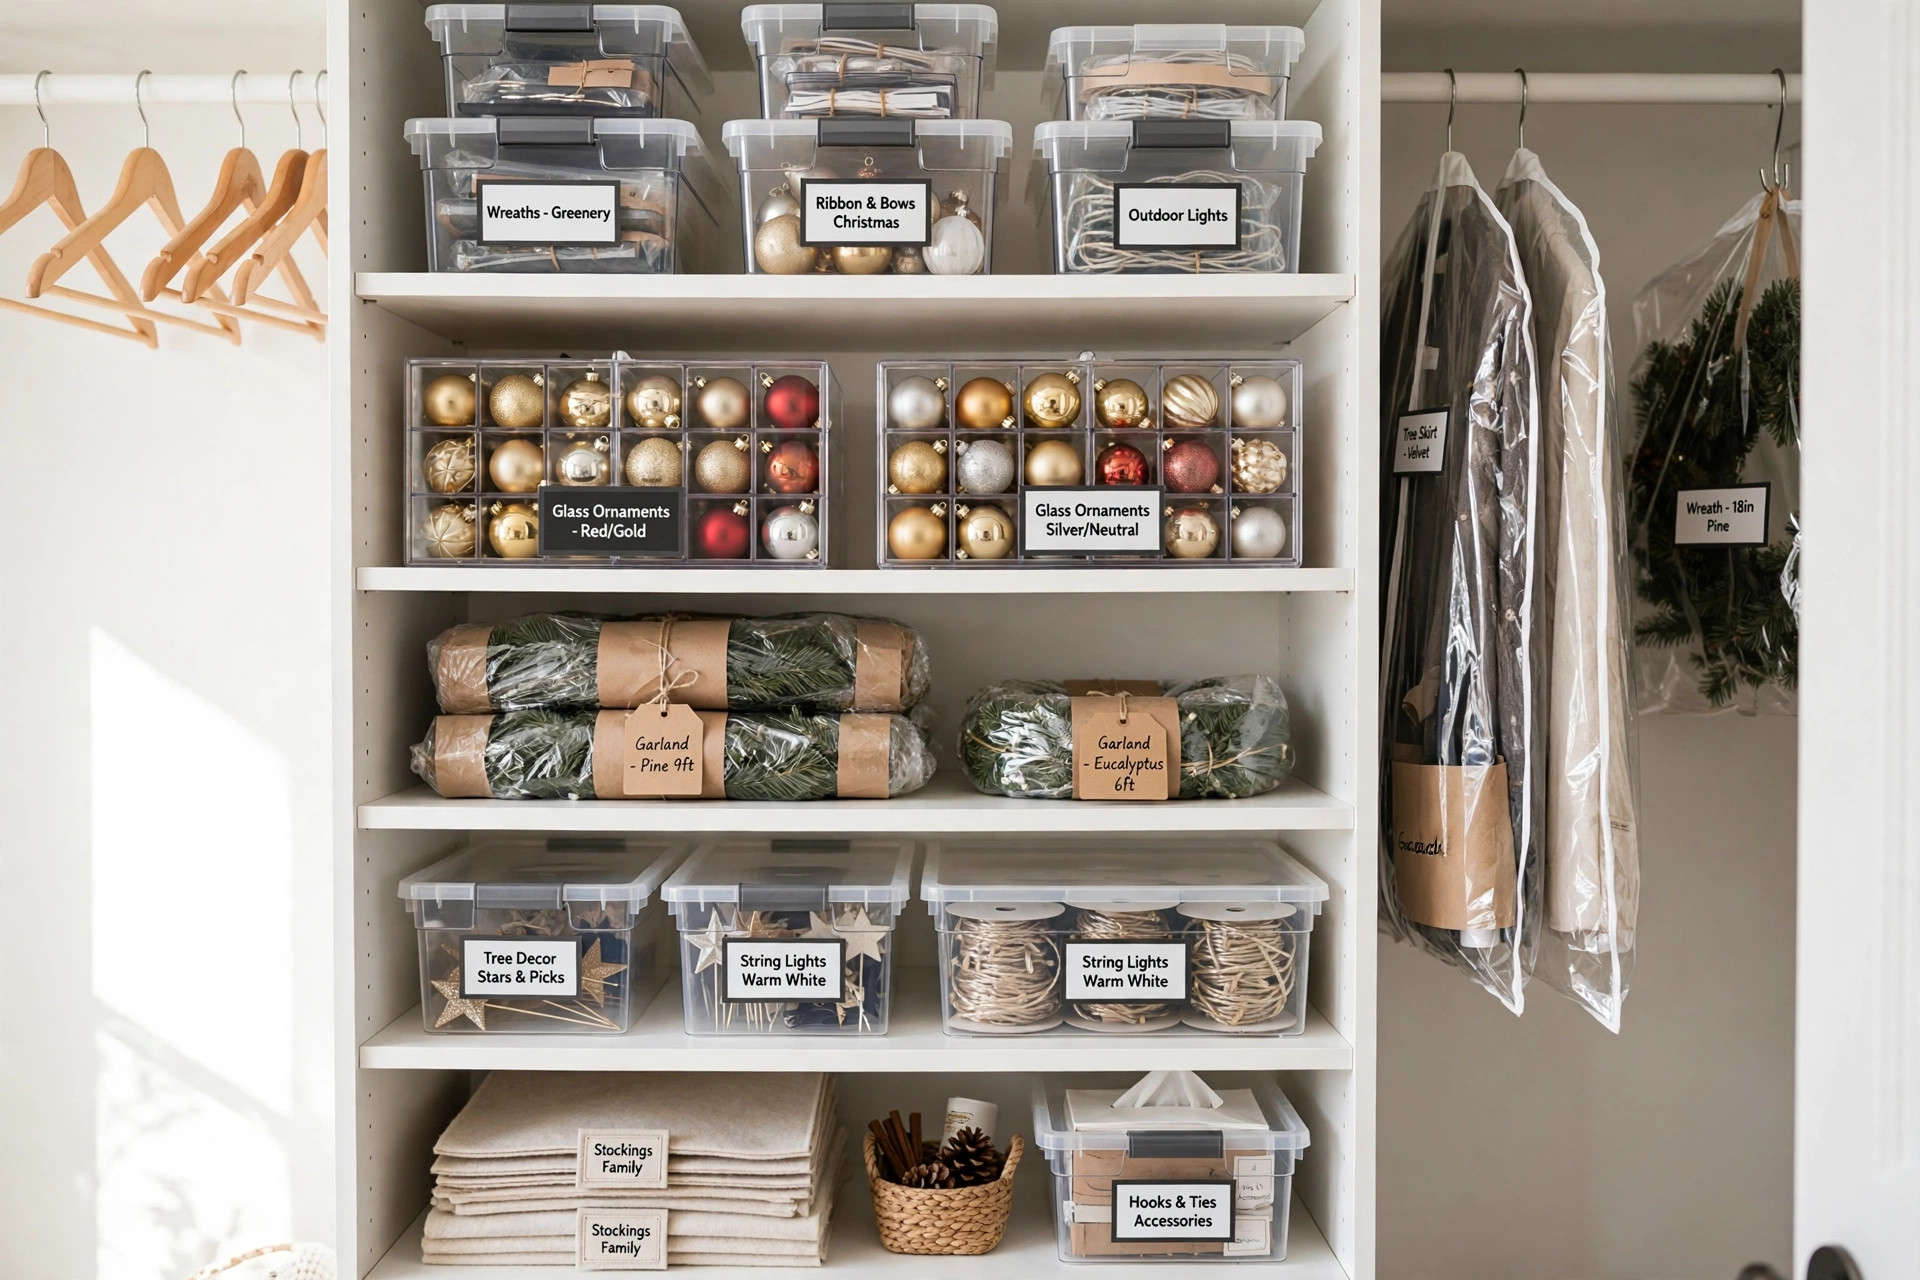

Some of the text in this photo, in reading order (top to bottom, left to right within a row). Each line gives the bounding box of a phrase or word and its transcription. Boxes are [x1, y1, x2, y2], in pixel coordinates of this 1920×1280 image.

[817, 196, 915, 209] Ribbon & Bows
[487, 206, 540, 219] Wreaths
[552, 206, 610, 222] Greenery
[834, 215, 899, 228] Christmas
[1129, 208, 1229, 225] Outdoor Lights
[1403, 425, 1438, 441] Tree Skirt
[1407, 444, 1430, 459] Velvet
[553, 504, 670, 518] Glass Ornaments
[1036, 503, 1150, 517] Glass Ornaments
[1686, 500, 1723, 515] Wreath
[1732, 499, 1755, 514] 18in
[581, 523, 646, 539] Red/Gold
[1047, 522, 1138, 537] Silver/Neutral
[1707, 519, 1730, 532] Pine
[636, 735, 689, 750] Garland
[1099, 735, 1150, 750] Garland
[641, 757, 669, 772] Pine
[673, 757, 695, 772] 9ft
[1095, 755, 1164, 776] Eucalyptus
[1115, 776, 1136, 792] 6ft
[484, 952, 556, 965] Tree Decor
[741, 954, 826, 971] String Lights
[1083, 955, 1168, 972] String Lights
[478, 970, 565, 983] Stars & Picks
[742, 973, 826, 986] Warm White
[1083, 974, 1168, 987] Warm White
[594, 1143, 653, 1160] Stockings
[602, 1160, 642, 1177] Family
[1130, 1195, 1216, 1208] Hooks & Ties
[1134, 1214, 1213, 1227] Accessories
[592, 1224, 651, 1240] Stockings
[601, 1241, 642, 1257] Family
